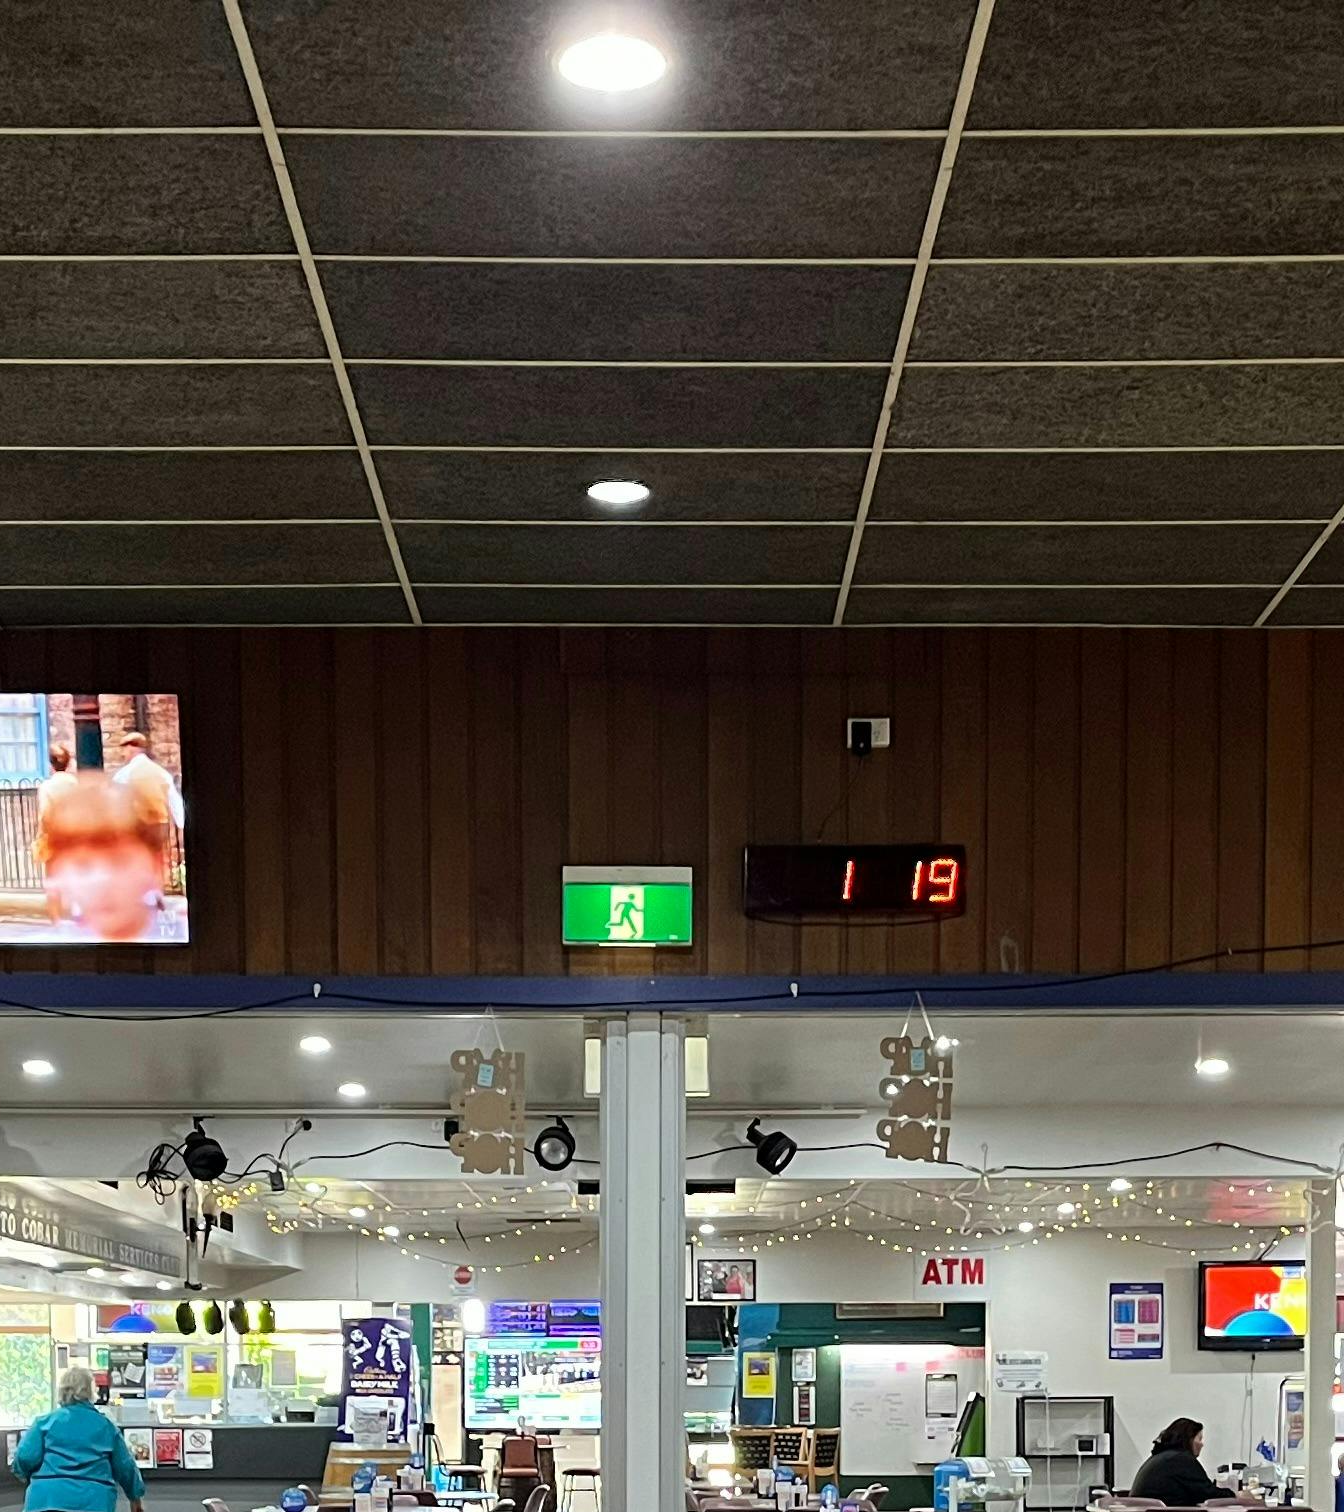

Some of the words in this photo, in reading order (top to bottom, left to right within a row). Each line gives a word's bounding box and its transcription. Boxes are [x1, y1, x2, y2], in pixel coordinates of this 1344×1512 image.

[913, 858, 958, 901] 19
[0, 1211, 16, 1235] TO
[21, 1218, 59, 1246] COBAR
[922, 1258, 984, 1285] ATM
